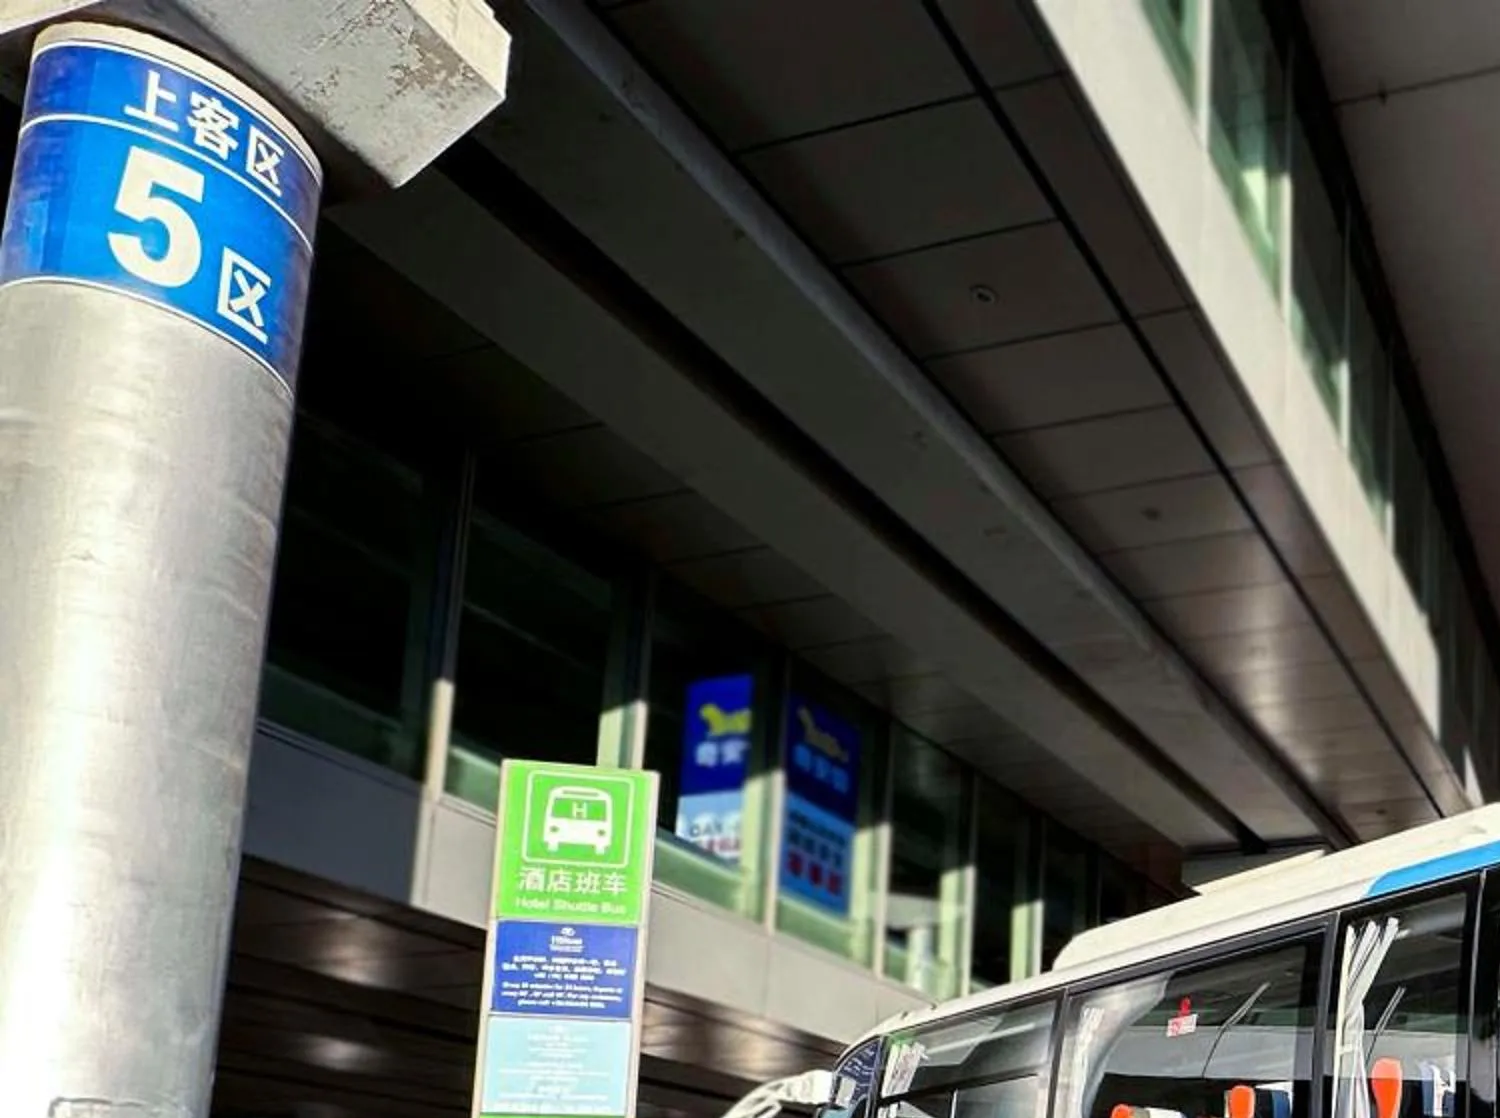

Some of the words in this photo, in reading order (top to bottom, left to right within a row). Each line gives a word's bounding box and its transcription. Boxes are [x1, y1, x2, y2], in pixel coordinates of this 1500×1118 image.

[124, 70, 284, 197] 上客区
[518, 866, 628, 898] 酒店班车
